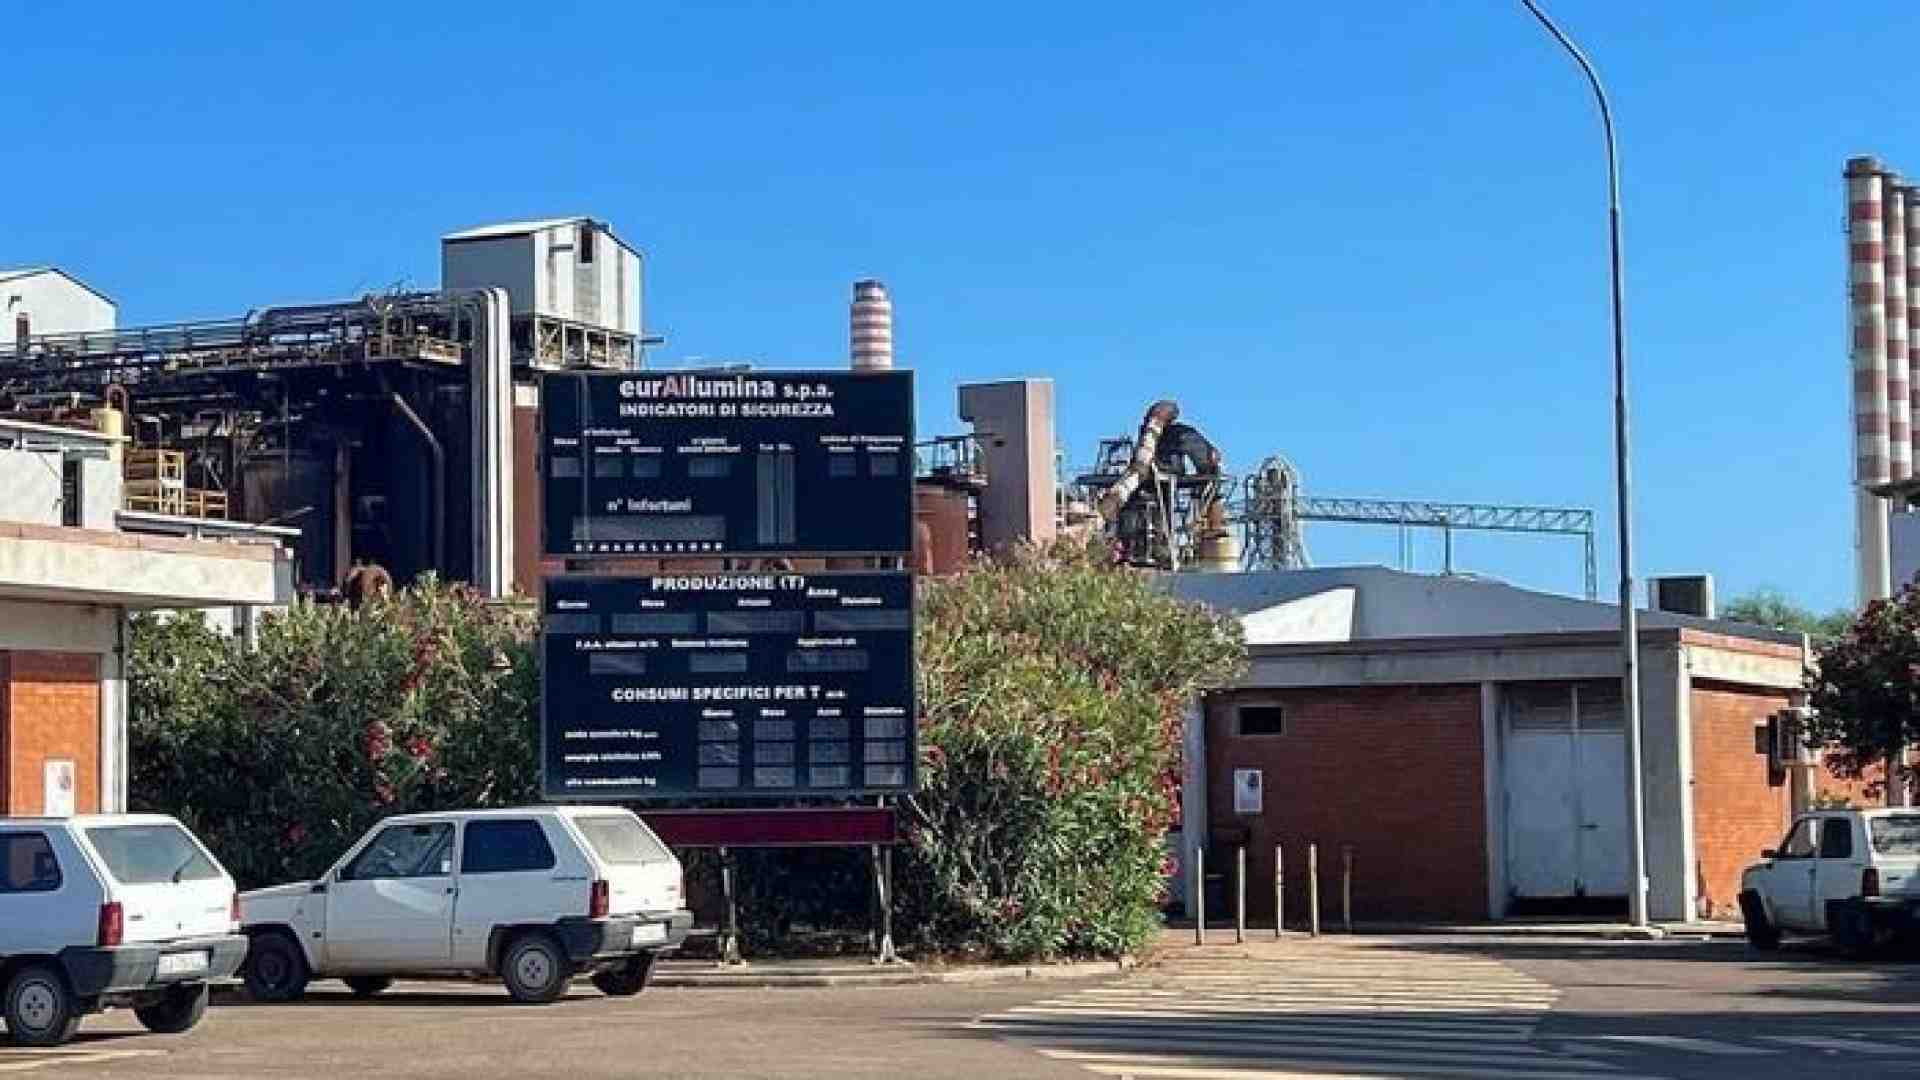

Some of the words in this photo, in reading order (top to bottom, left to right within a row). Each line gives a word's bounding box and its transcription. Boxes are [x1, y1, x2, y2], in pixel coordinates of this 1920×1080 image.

[620, 403, 715, 418] INDICATORI
[720, 403, 736, 417] DI
[741, 402, 835, 417] SICUREZZA
[652, 576, 776, 591] PRODUZIONE
[611, 687, 688, 700] CONSUMI
[693, 686, 771, 700] SPECIFICI
[775, 685, 806, 699] PER
[809, 685, 821, 698] T
